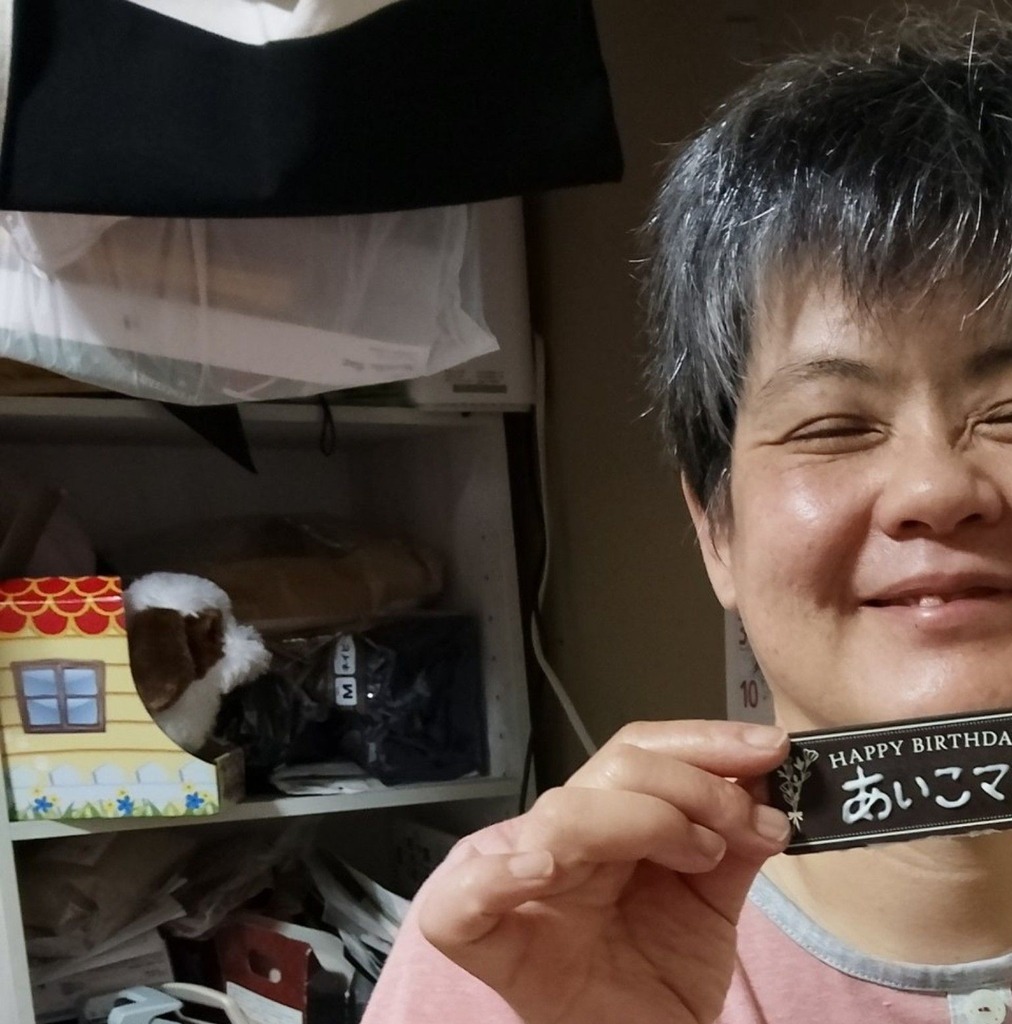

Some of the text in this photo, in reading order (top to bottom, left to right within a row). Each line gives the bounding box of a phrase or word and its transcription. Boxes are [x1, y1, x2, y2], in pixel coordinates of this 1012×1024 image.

[342, 684, 353, 699] M
[740, 680, 759, 708] 10
[829, 740, 904, 769] HAPPY
